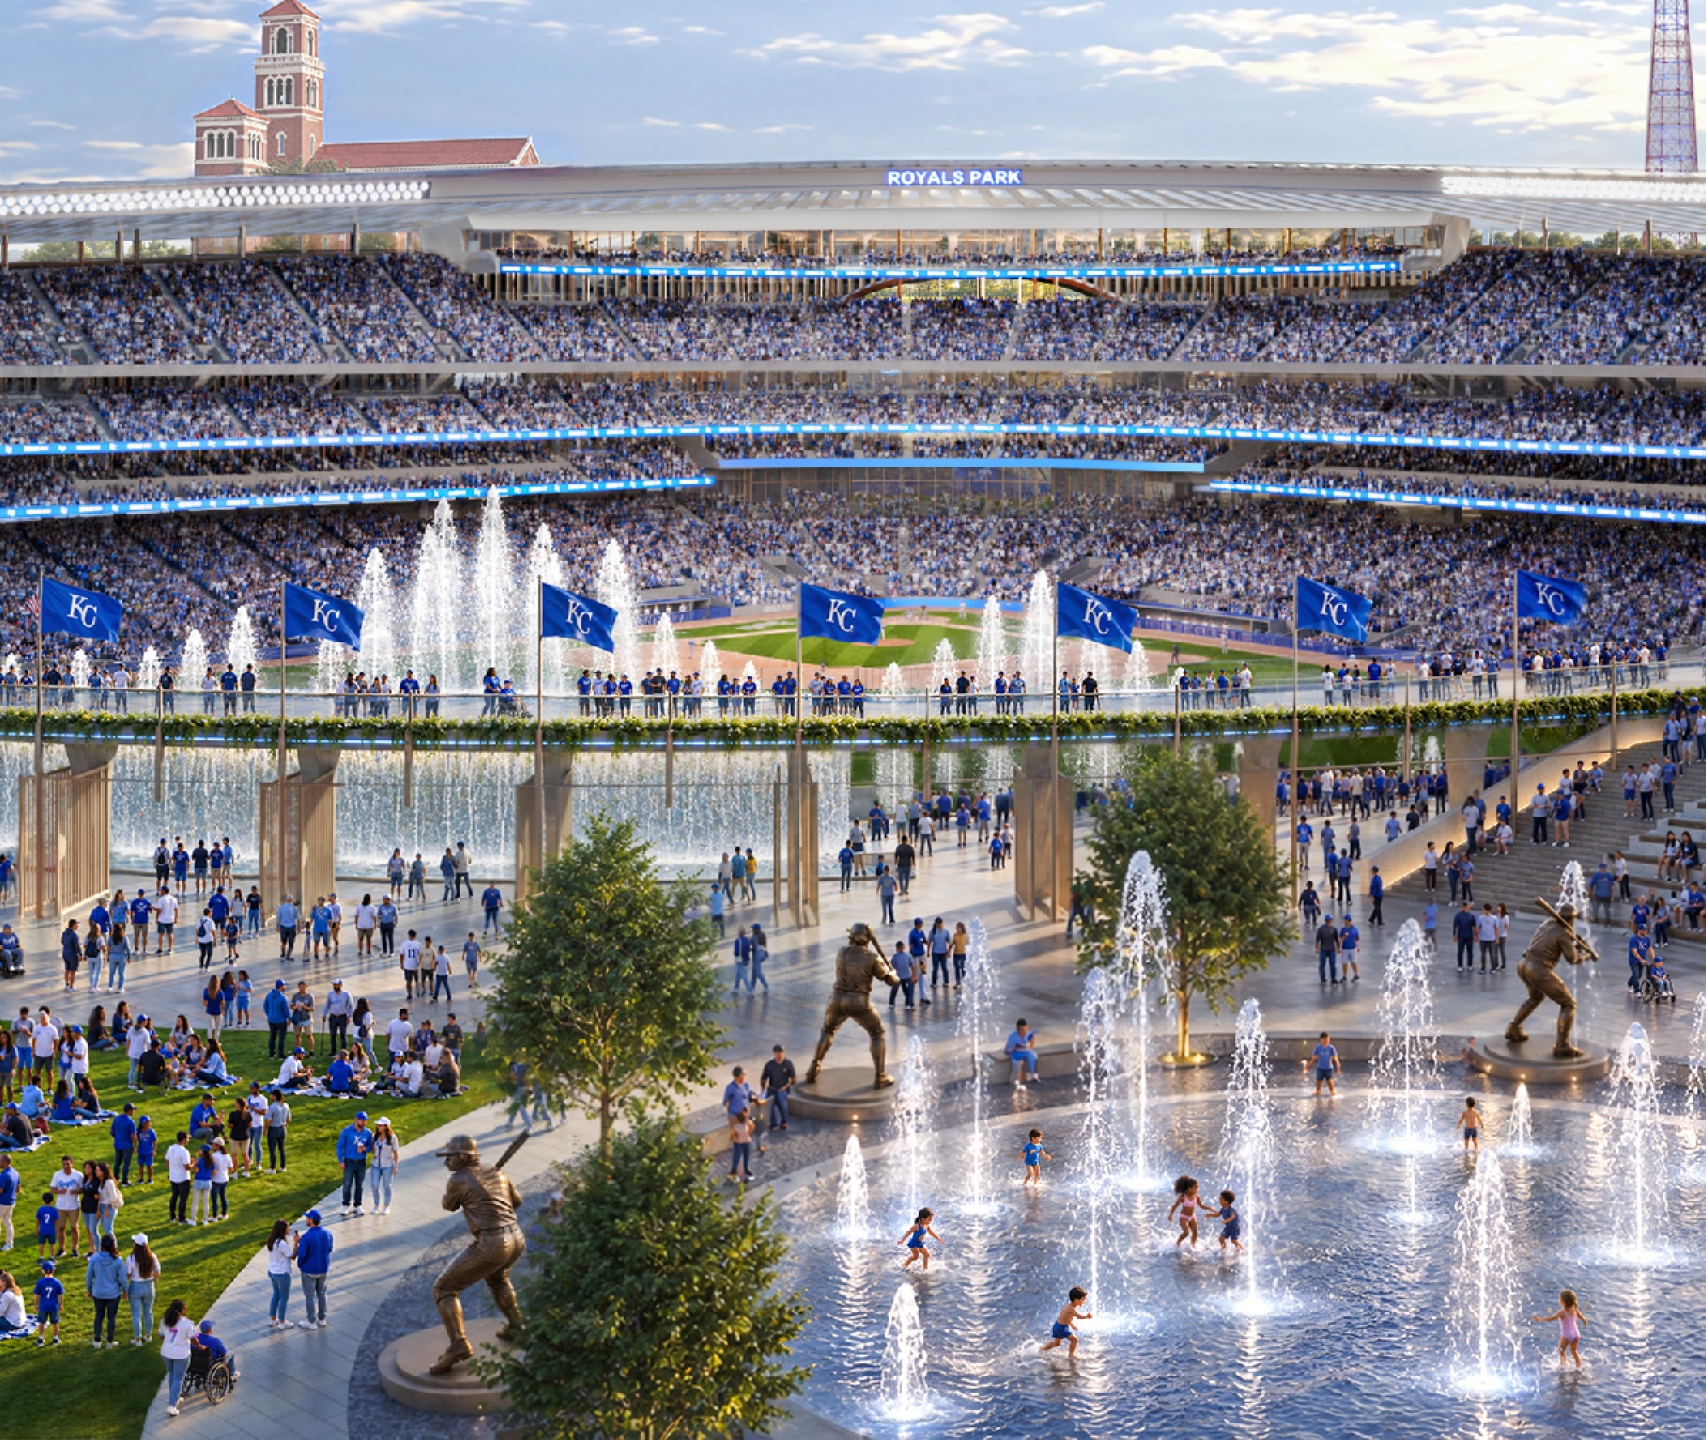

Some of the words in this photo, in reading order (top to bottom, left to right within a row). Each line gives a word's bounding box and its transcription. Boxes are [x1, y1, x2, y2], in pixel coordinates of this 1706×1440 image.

[888, 170, 964, 185] ROYALS
[969, 169, 1021, 185] PARK
[66, 593, 98, 629] KC
[311, 598, 341, 633] KC
[827, 598, 857, 633] KC
[1081, 598, 1111, 634] KC
[1321, 591, 1348, 627] KC
[1535, 581, 1565, 616] KC
[566, 599, 594, 634] KC
[45, 1287, 54, 1299] 7
[169, 1328, 179, 1343] 7
